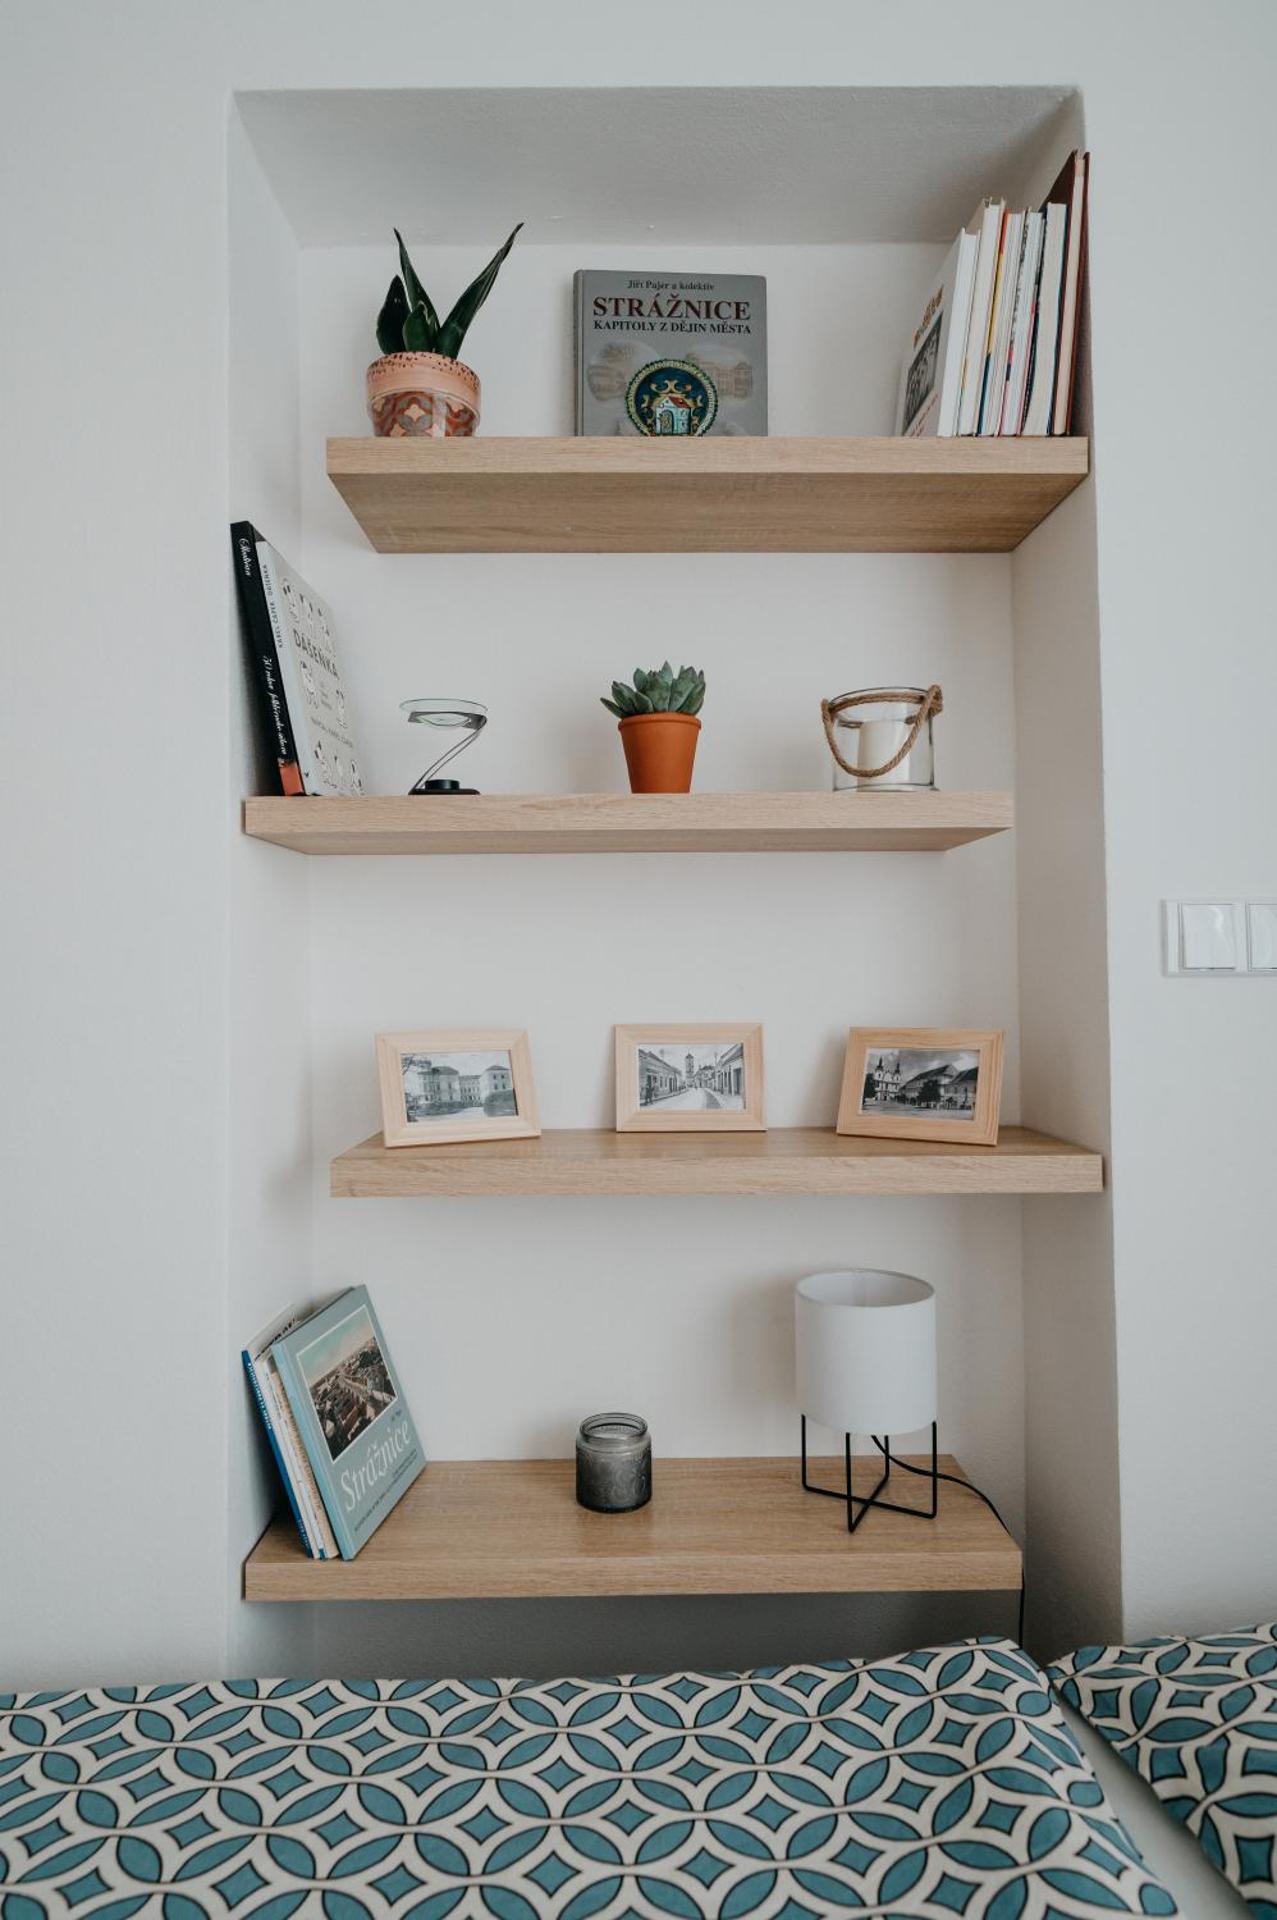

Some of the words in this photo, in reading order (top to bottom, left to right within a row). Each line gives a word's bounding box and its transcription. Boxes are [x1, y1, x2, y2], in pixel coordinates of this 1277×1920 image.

[627, 279, 645, 289] Jiří
[646, 280, 669, 291] Pajer
[679, 281, 715, 291] kolektiv
[592, 293, 751, 321] STRÁŽNICE
[593, 320, 656, 332] KAPITOLY
[659, 321, 668, 332] Z
[671, 320, 707, 333] DĚJIN
[709, 320, 751, 334] MĚSTA
[340, 1420, 411, 1511] Strážnice
